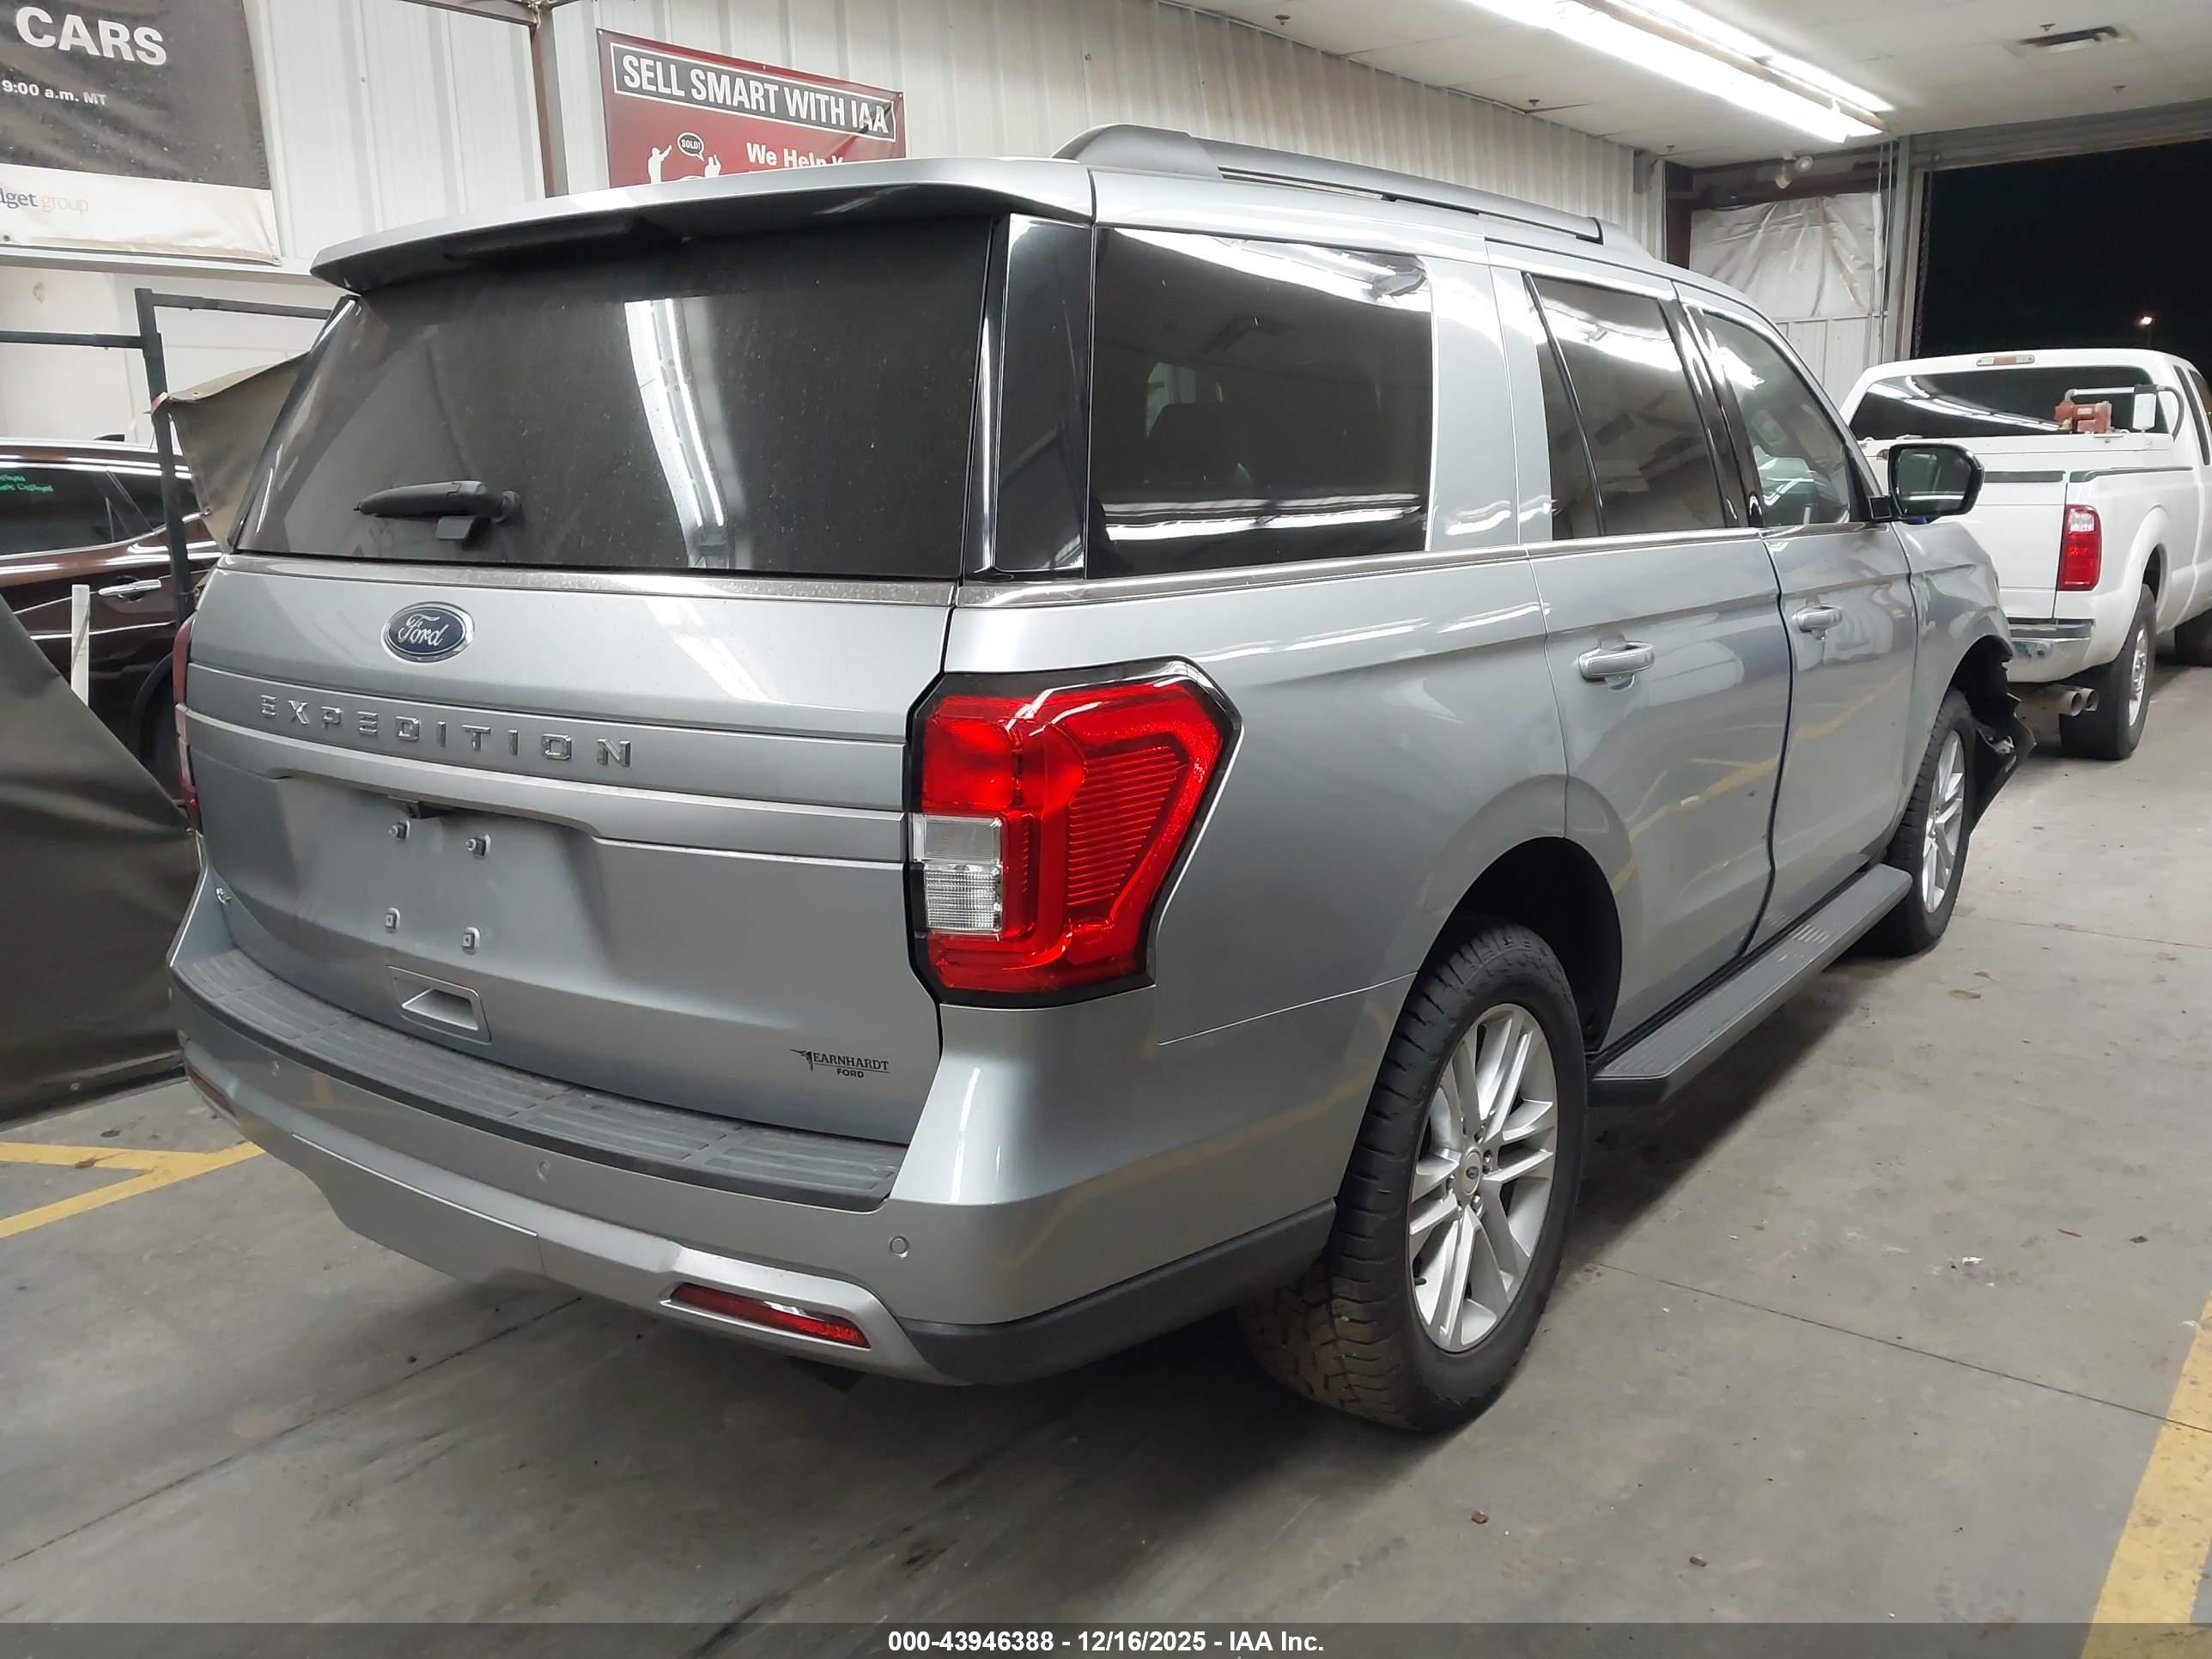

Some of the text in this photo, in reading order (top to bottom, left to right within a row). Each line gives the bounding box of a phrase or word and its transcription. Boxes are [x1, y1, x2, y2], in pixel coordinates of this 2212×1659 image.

[15, 6, 167, 65] CARS
[1, 79, 107, 106] 9:00 a.m. MT
[623, 55, 889, 133] SELL SMART WITH IAA
[681, 138, 701, 150] SOLD!
[746, 142, 777, 166] We
[41, 196, 88, 216] group
[398, 613, 449, 647] Ford
[260, 694, 631, 768] EXPEDITION
[813, 1052, 890, 1070] EARNHARDT
[836, 1068, 864, 1078] FORD
